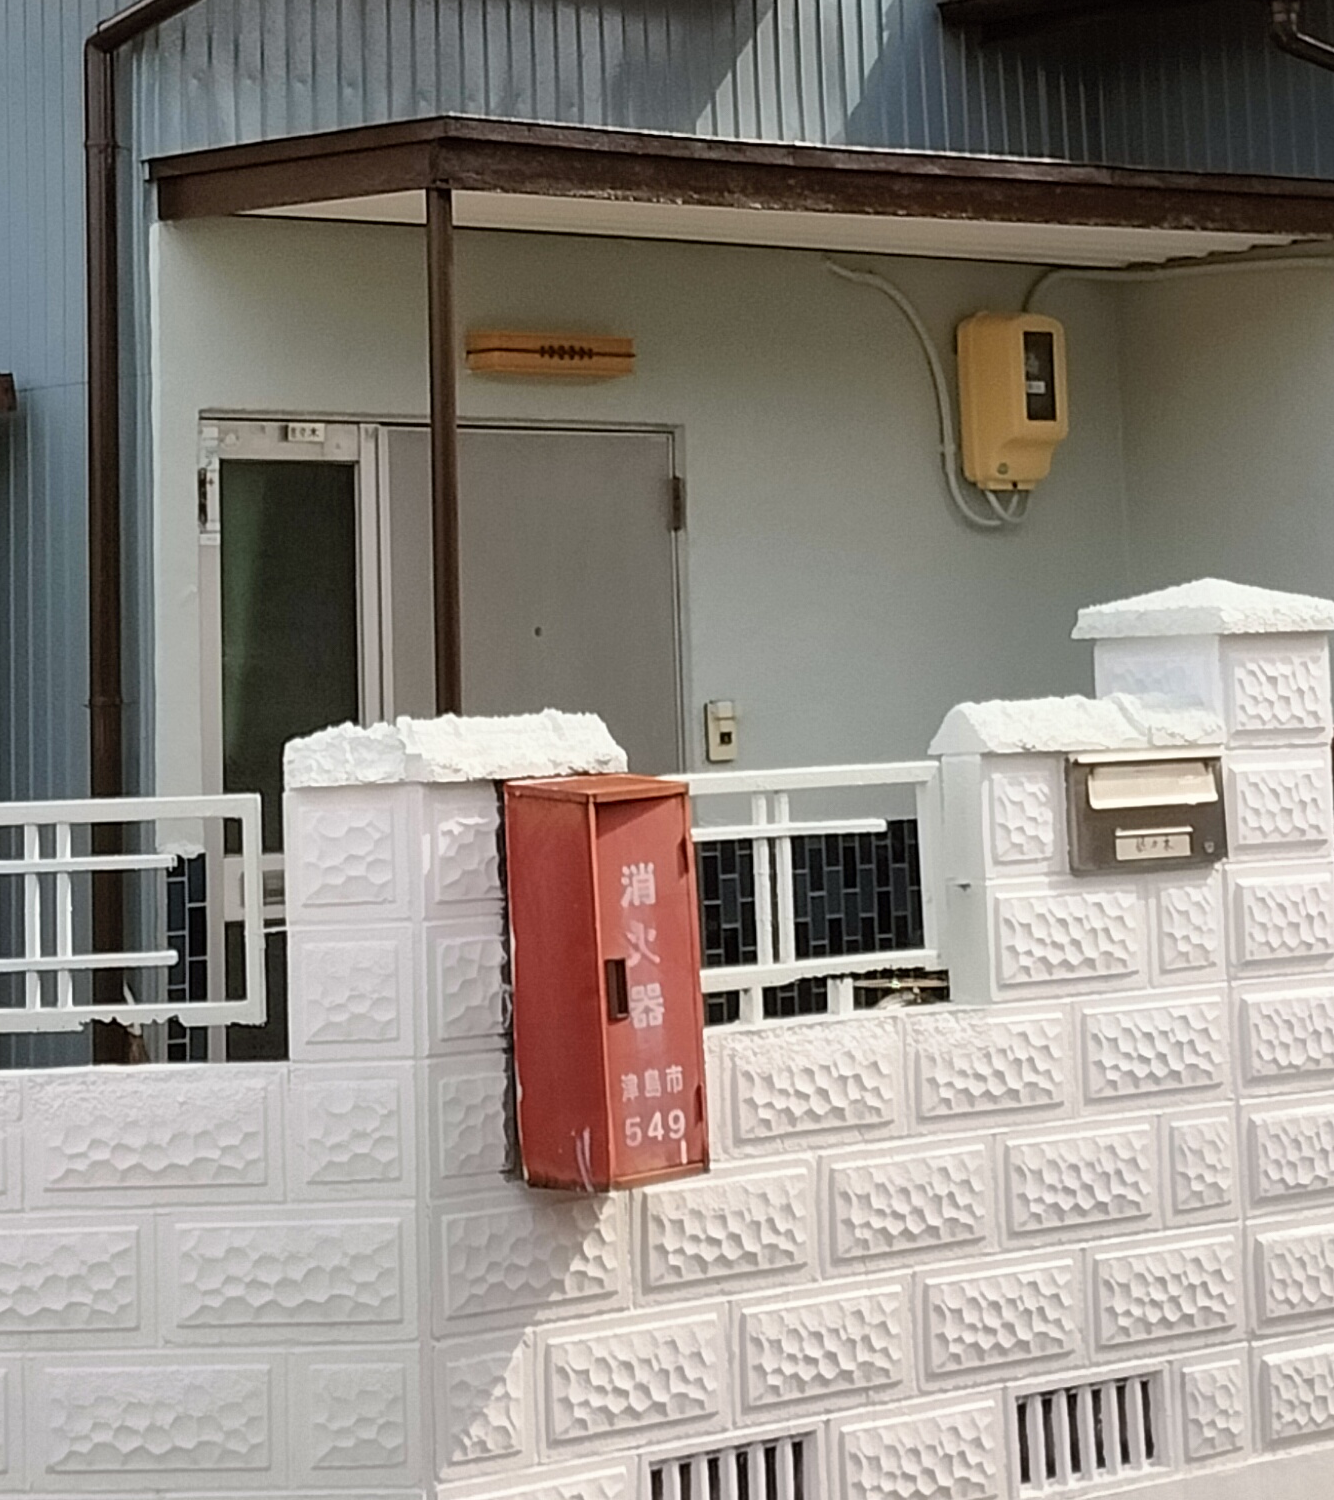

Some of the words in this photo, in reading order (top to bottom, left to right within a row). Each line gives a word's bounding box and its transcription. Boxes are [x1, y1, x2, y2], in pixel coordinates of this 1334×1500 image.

[620, 861, 666, 1029] 消火器
[624, 1108, 686, 1147] 549
